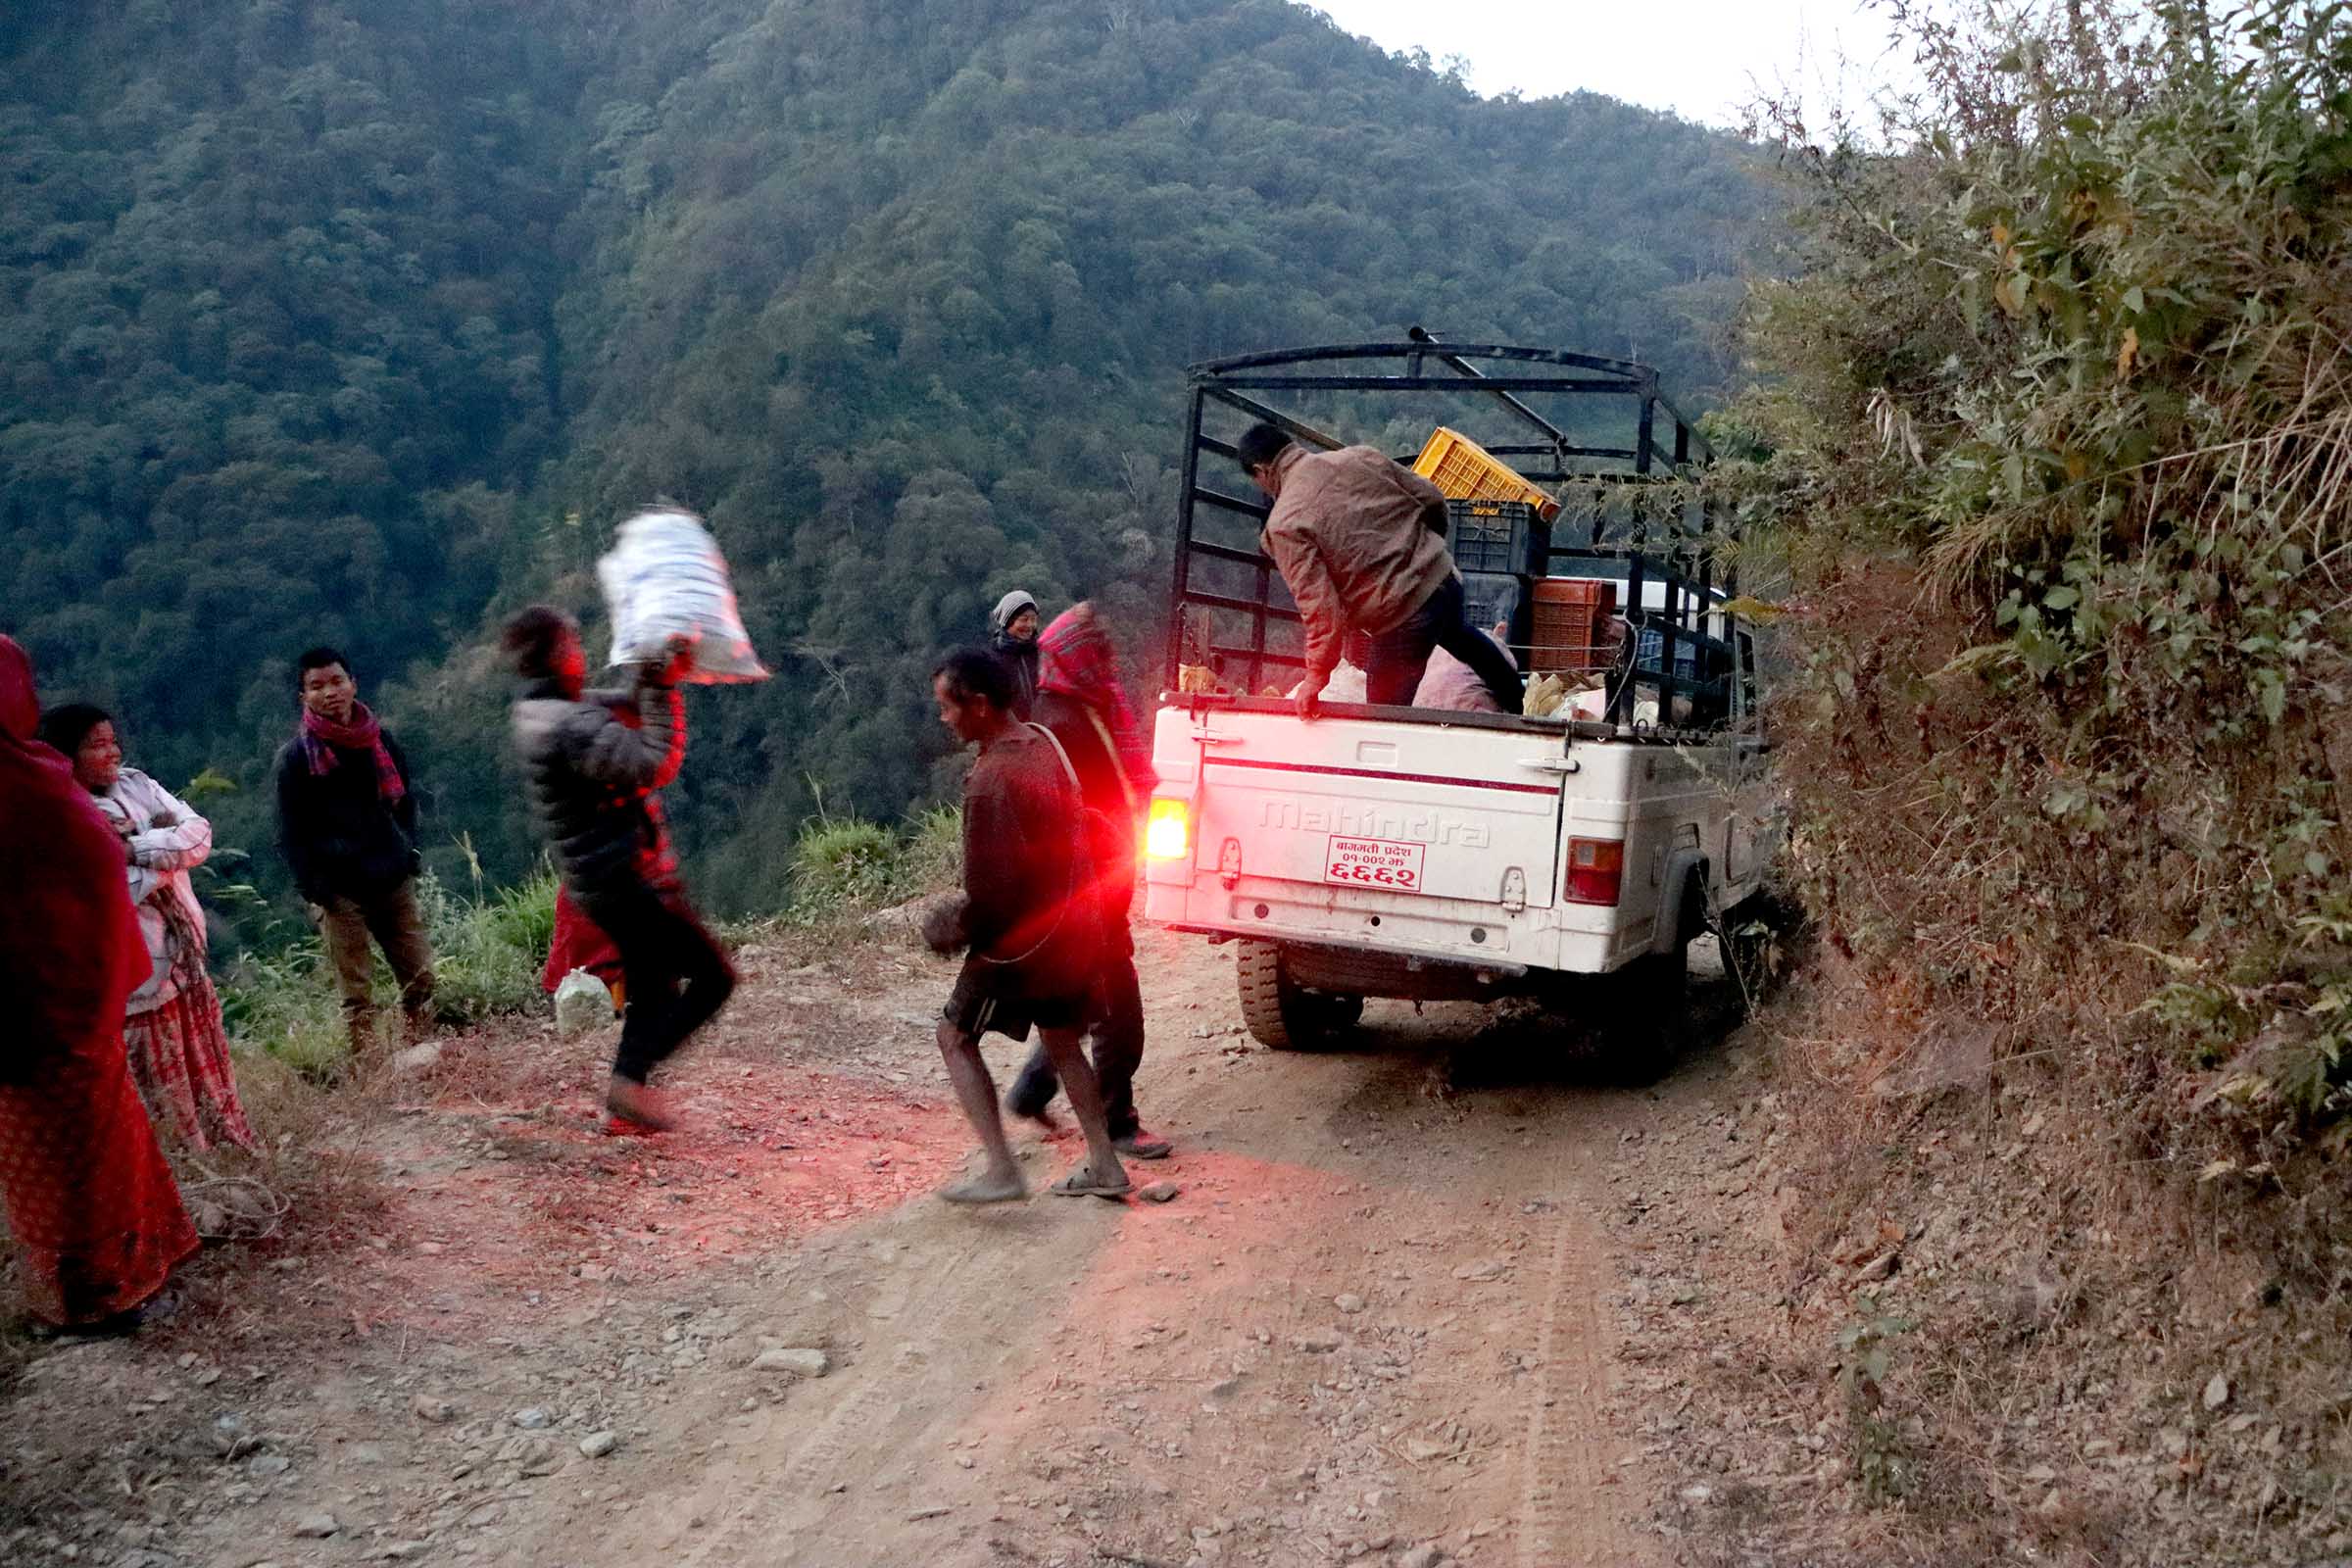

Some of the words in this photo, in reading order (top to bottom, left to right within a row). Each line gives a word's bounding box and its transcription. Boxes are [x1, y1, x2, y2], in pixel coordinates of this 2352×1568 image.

[1258, 801, 1492, 848] Mahindra
[1384, 845, 1412, 857] प्रदेश
[1330, 861, 1416, 888] ६६६२
